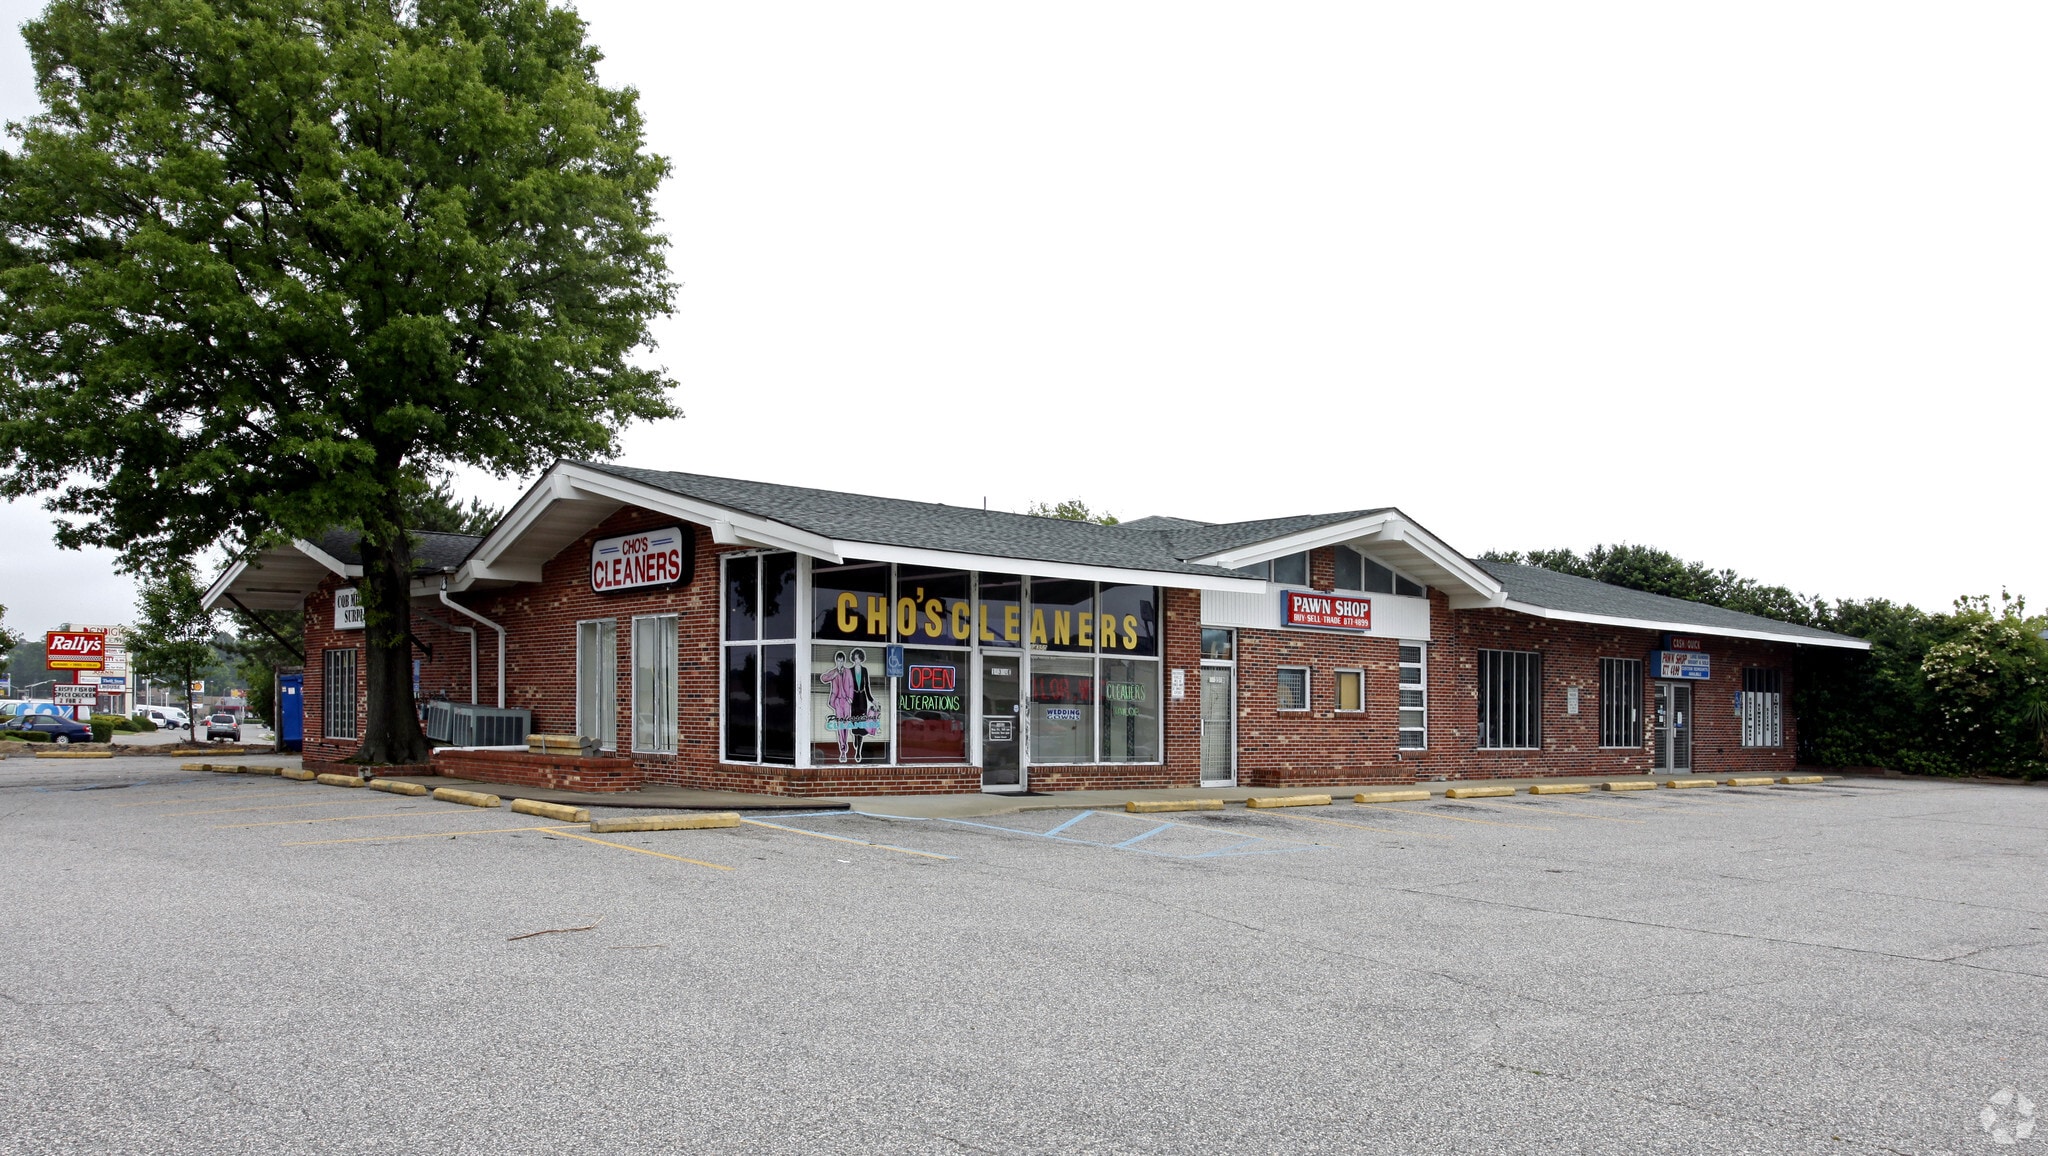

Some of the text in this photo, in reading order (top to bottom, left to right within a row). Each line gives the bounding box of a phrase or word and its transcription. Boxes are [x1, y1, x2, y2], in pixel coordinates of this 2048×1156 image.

[622, 536, 648, 555] CHO'S
[593, 549, 680, 589] CLEANERS
[1293, 596, 1369, 617] PAWN SHOP
[836, 586, 1138, 650] CHO'S CLEANERS
[1293, 613, 1305, 622] BUY
[1306, 614, 1322, 623] SELL
[1323, 616, 1341, 625] TRADE
[49, 635, 102, 654] Rally's
[910, 667, 955, 690] OPEN
[898, 695, 960, 711] ALTERATIONS
[826, 712, 882, 724] Professional
